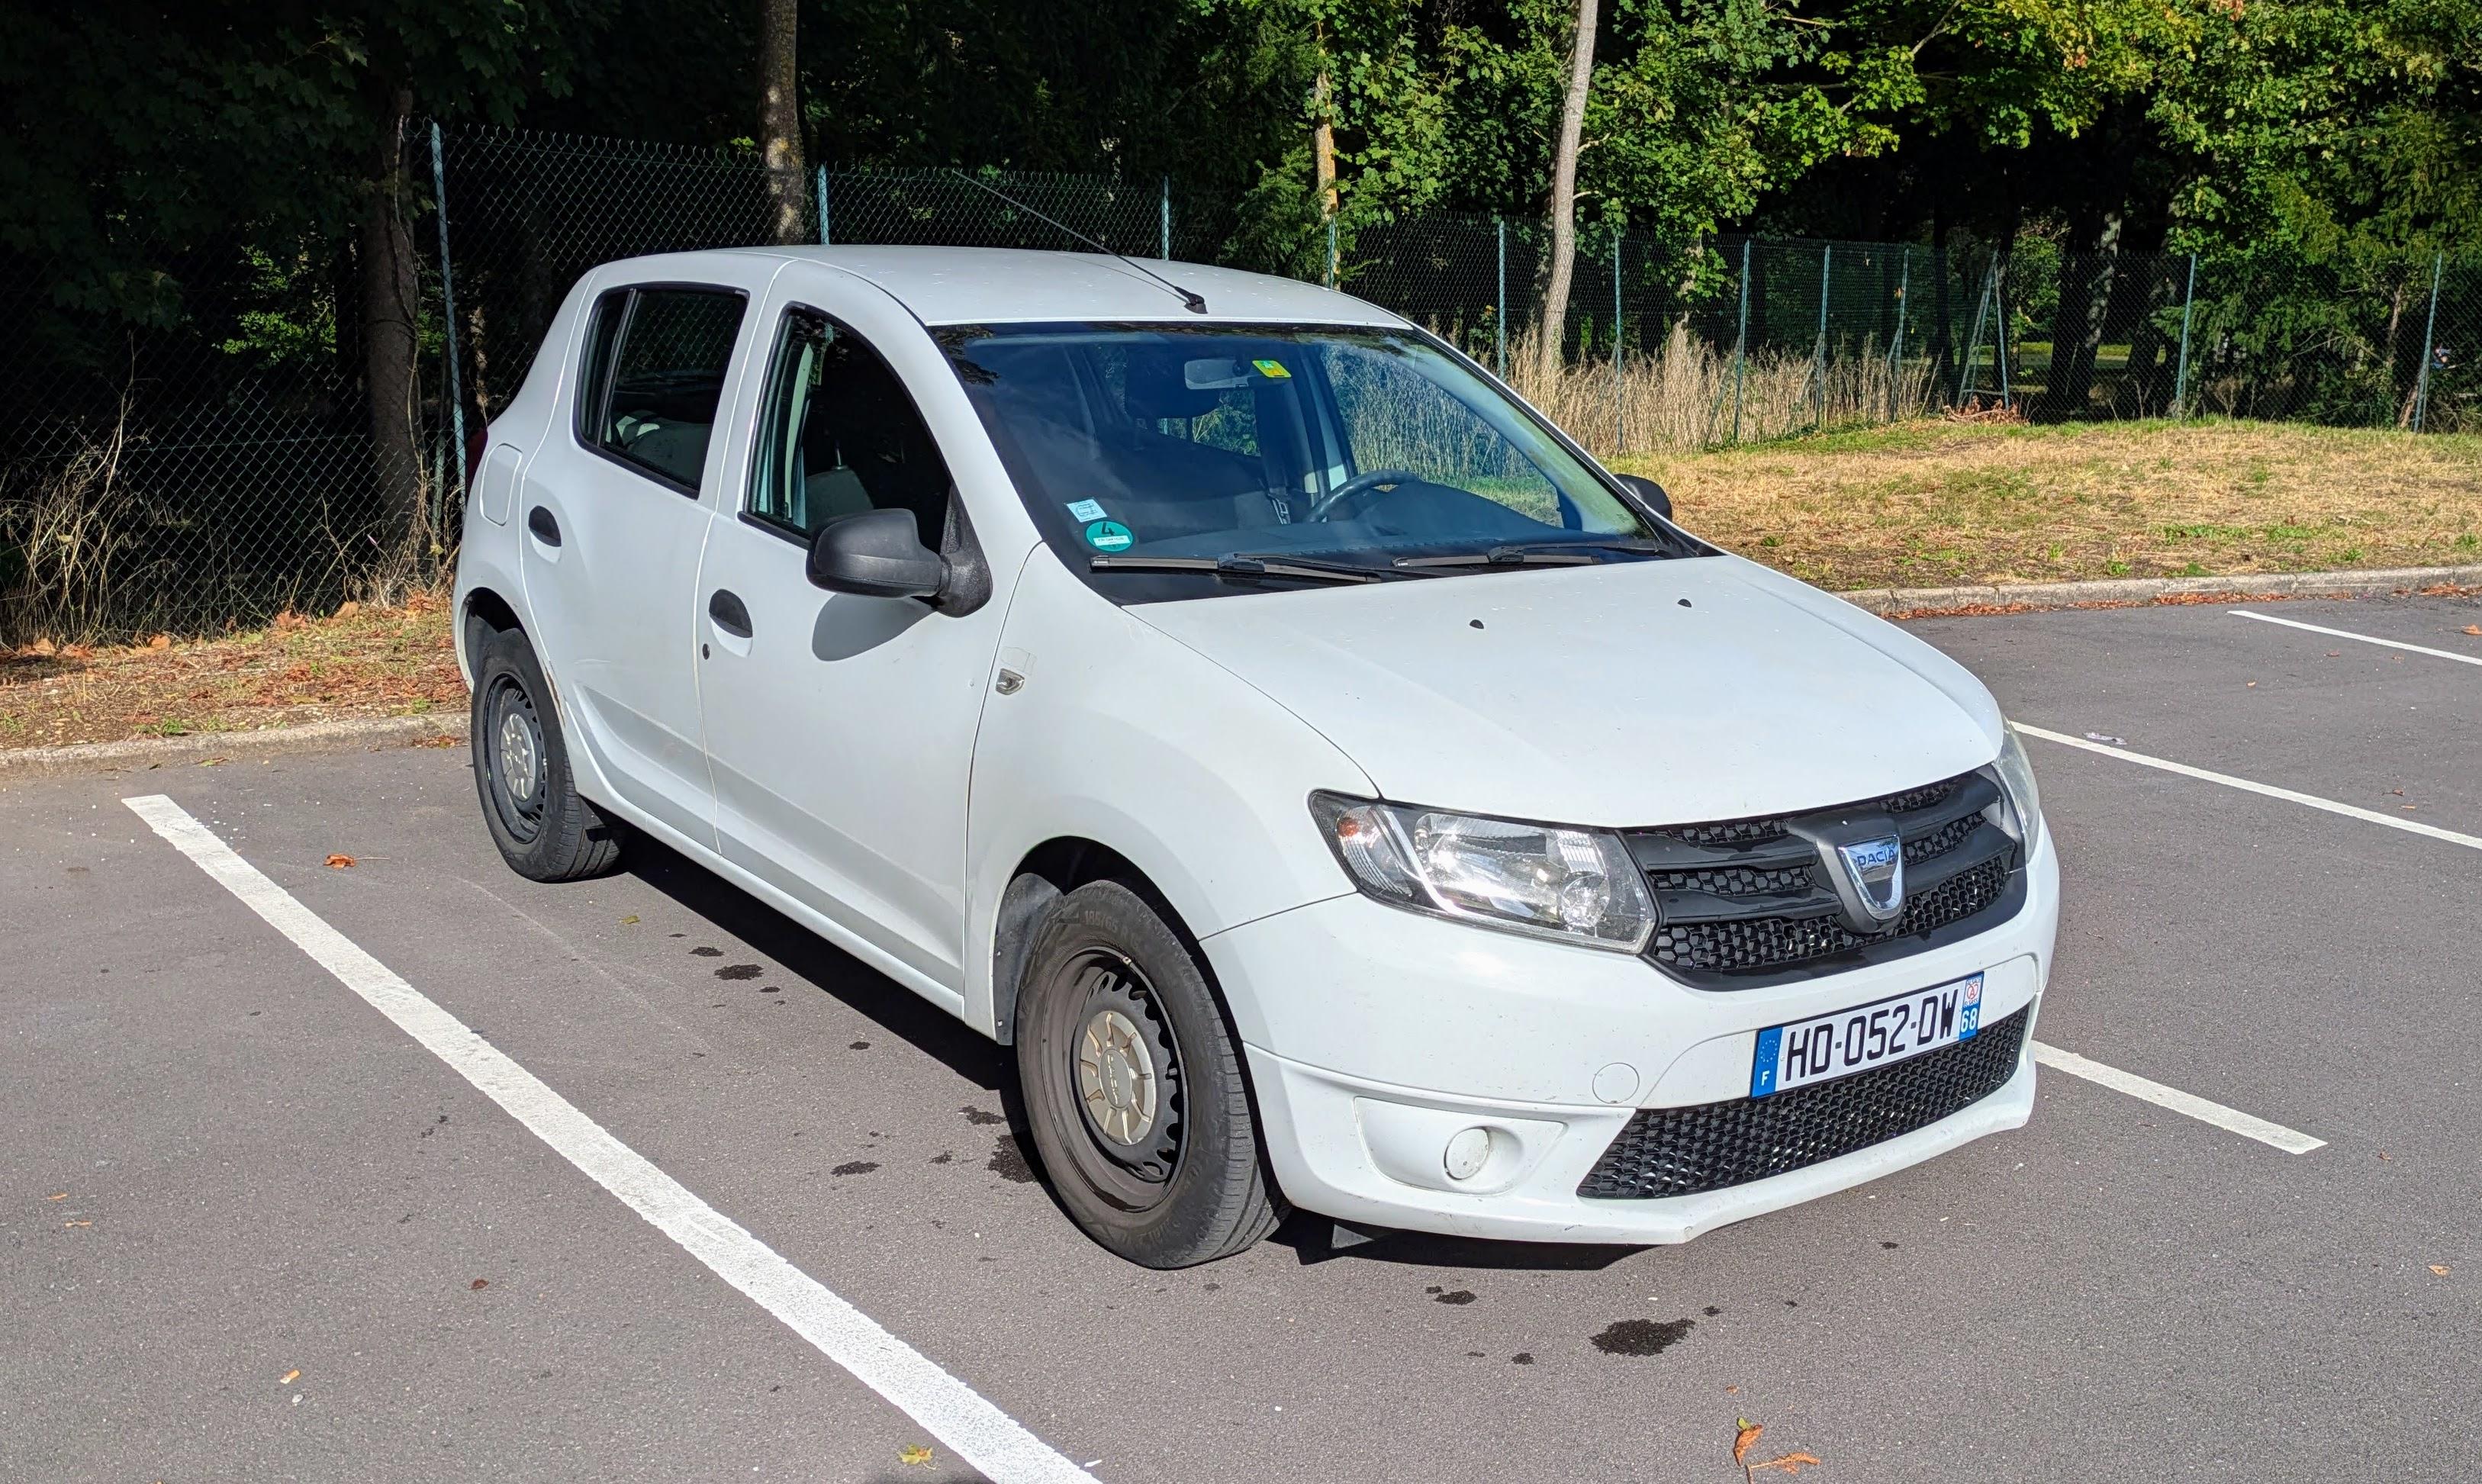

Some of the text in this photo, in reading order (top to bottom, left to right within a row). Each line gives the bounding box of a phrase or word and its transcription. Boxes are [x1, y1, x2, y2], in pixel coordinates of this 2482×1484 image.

[1102, 523, 1115, 536] 4
[1857, 848, 1895, 866] DACIA
[1761, 990, 1978, 1086] F HD-052-DW 68
